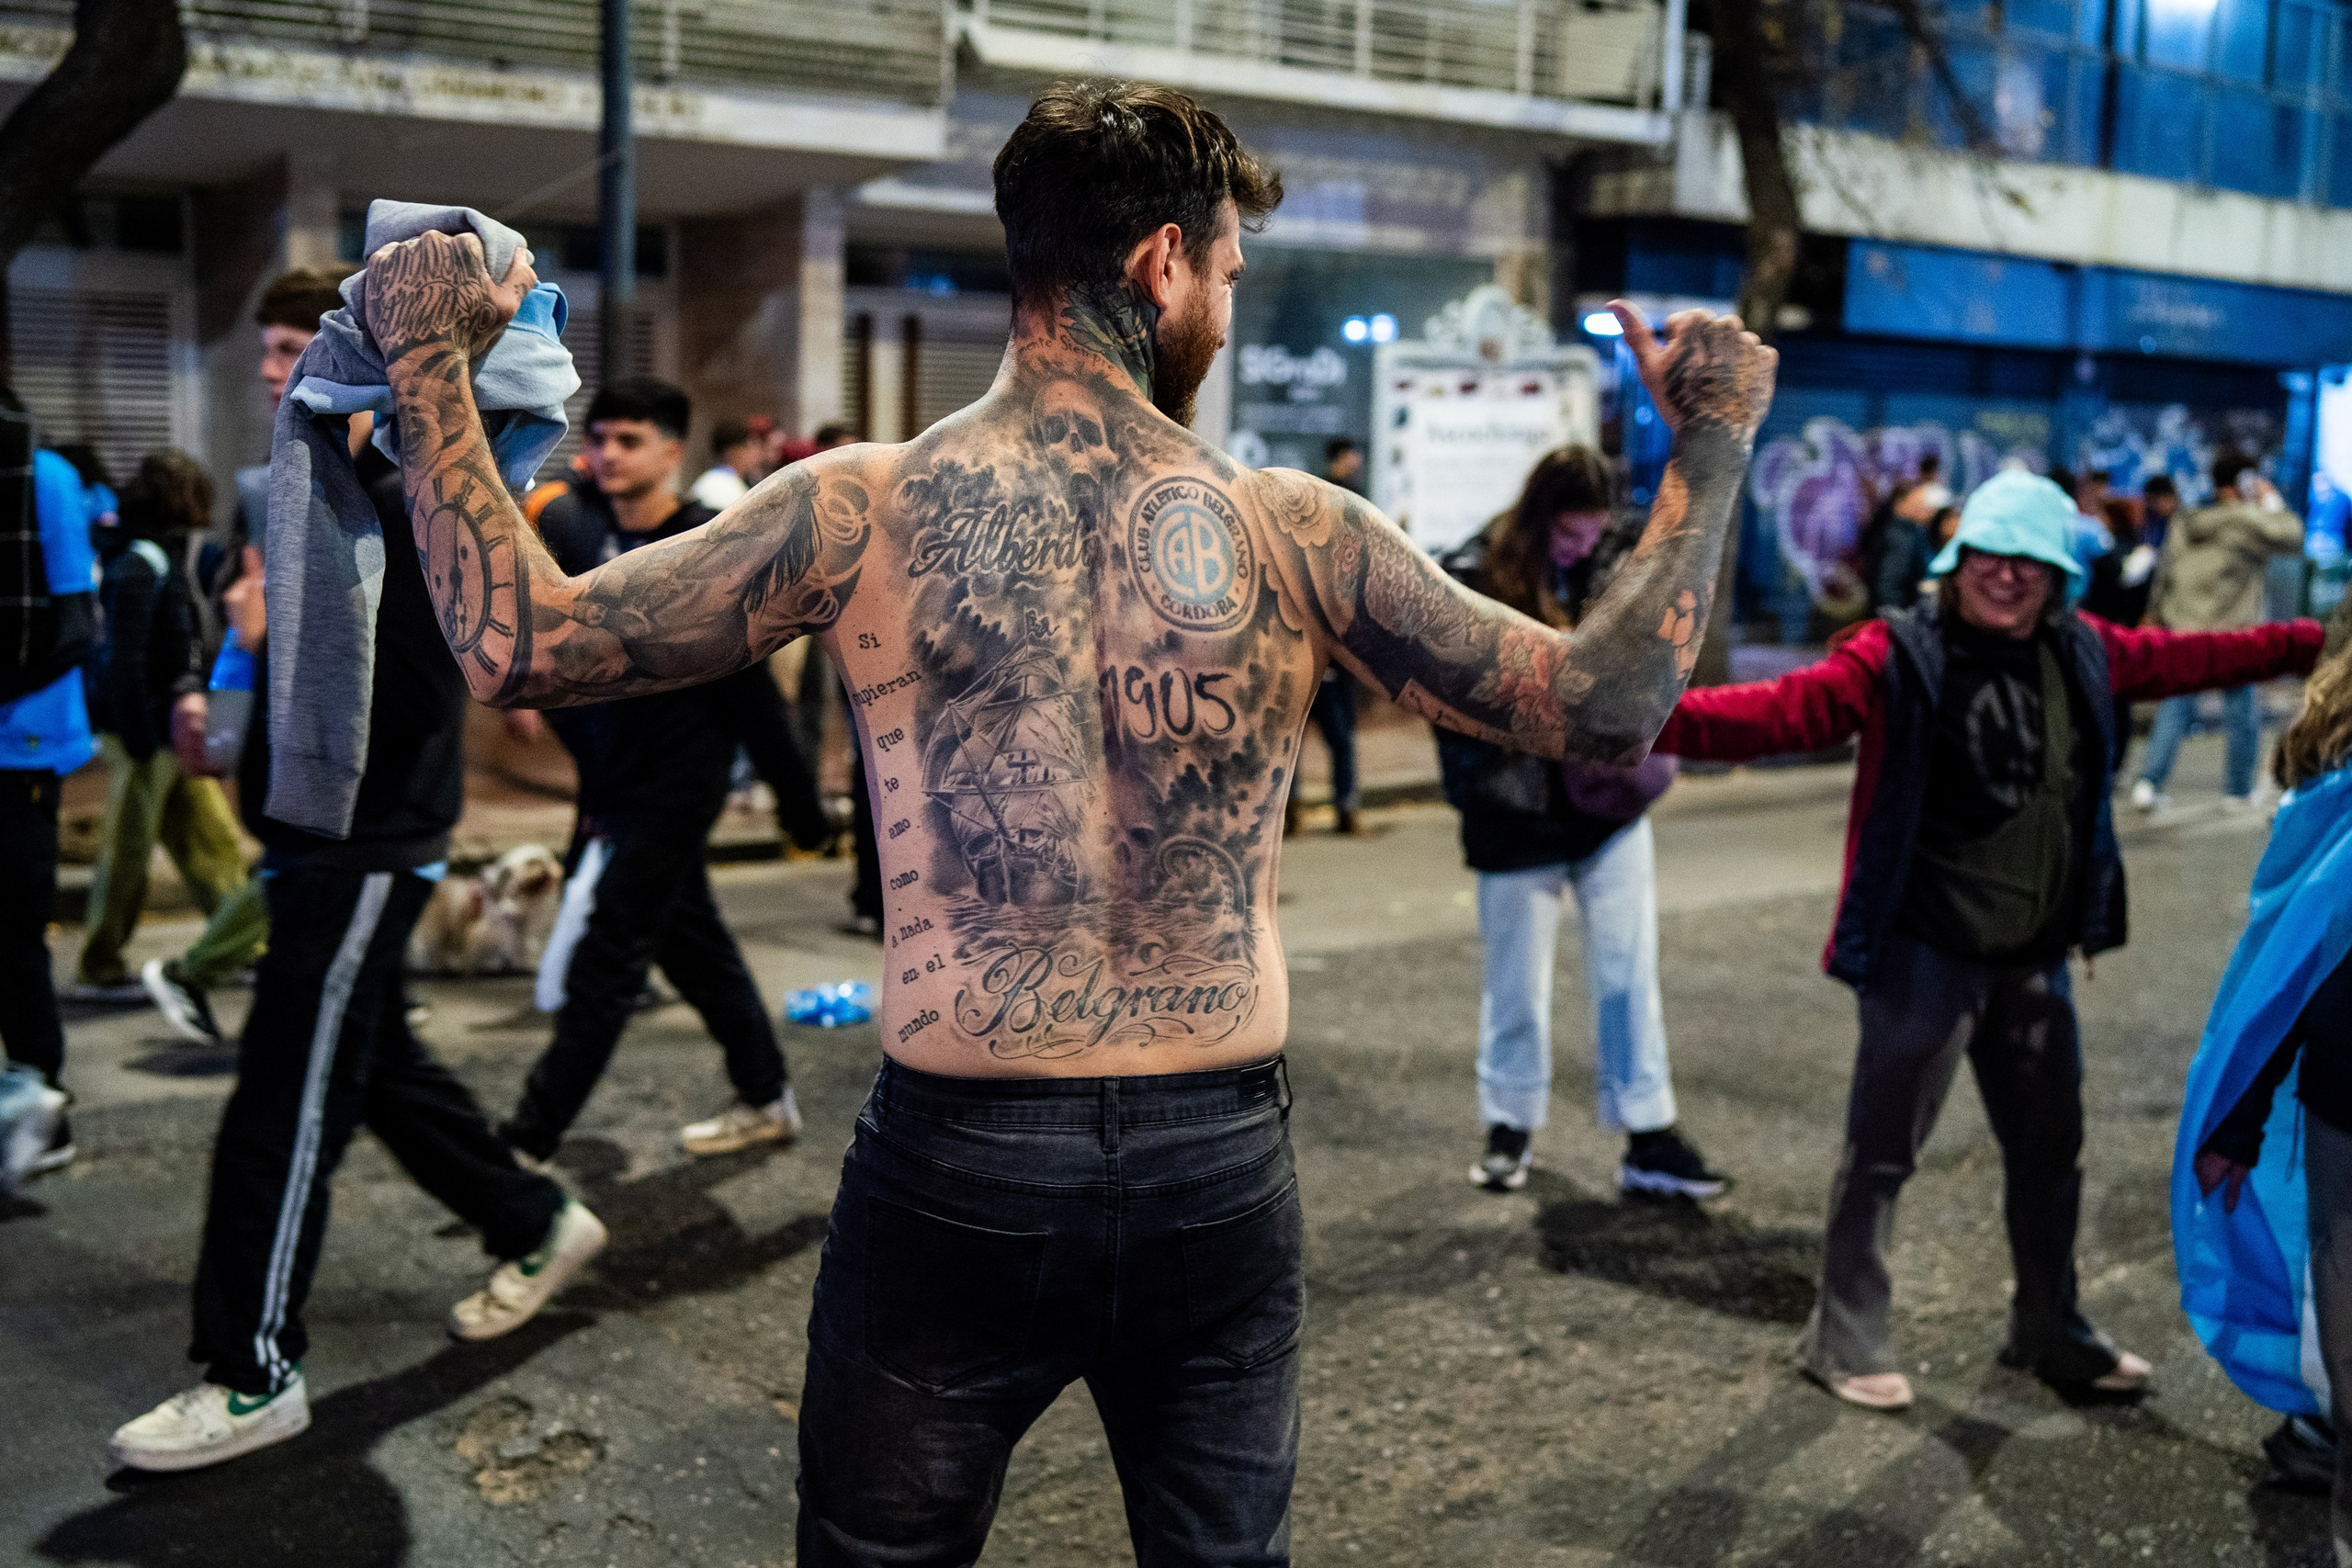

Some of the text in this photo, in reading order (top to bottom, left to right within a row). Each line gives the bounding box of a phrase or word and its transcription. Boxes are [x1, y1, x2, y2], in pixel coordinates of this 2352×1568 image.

[1137, 486, 1248, 580] CLUB ATLETICO BELGRANO
[858, 634, 881, 649] Si
[853, 670, 922, 707] supieran
[1100, 664, 1236, 739] 1905
[876, 728, 905, 752] que
[884, 777, 899, 793] te
[888, 818, 911, 840] amo
[889, 869, 919, 890] como
[892, 917, 933, 948] a nada
[902, 953, 945, 985] en el
[956, 943, 1251, 1048] Belgrano
[898, 1010, 939, 1043] mundo
